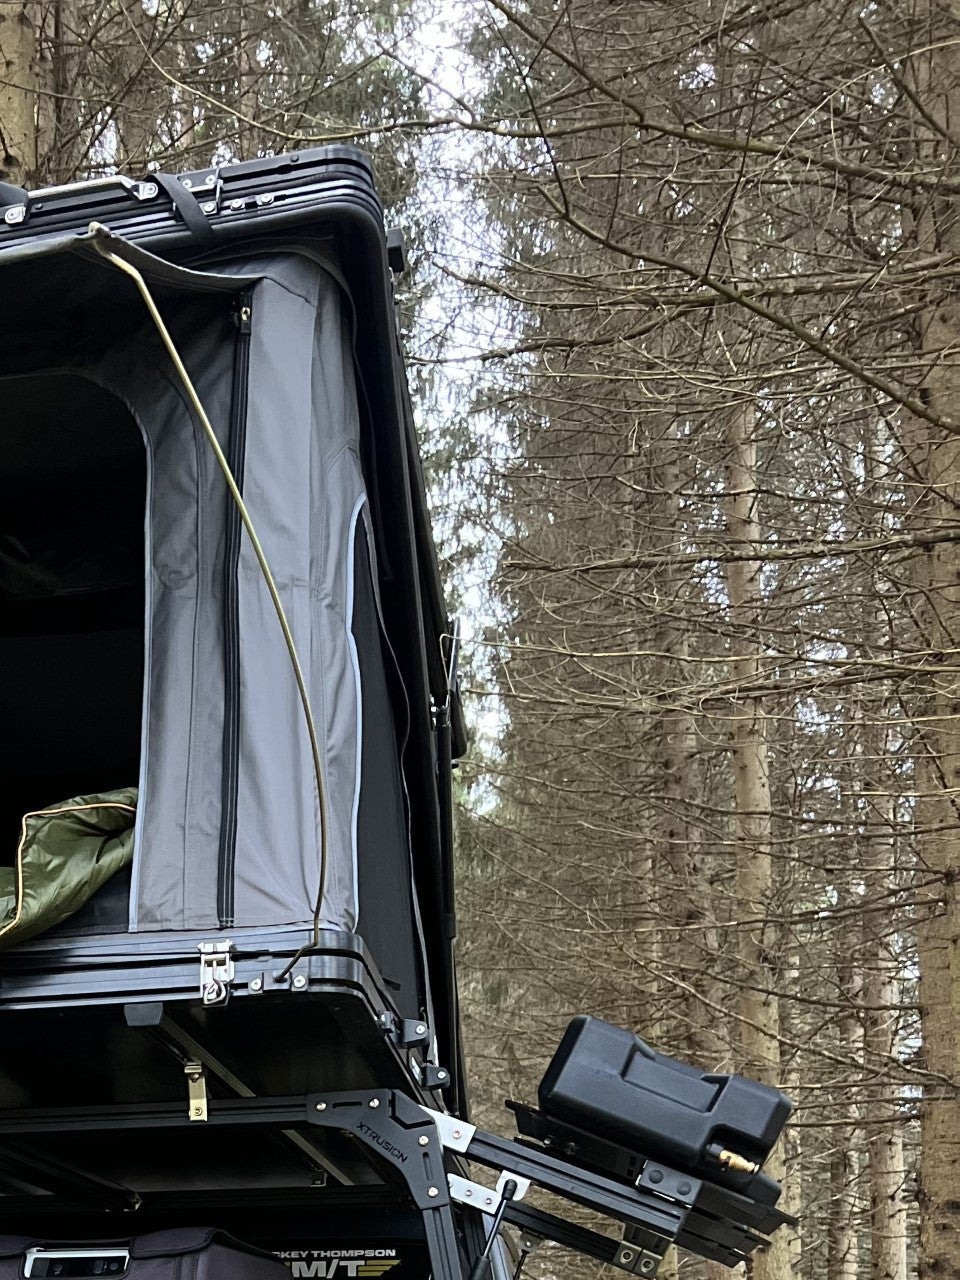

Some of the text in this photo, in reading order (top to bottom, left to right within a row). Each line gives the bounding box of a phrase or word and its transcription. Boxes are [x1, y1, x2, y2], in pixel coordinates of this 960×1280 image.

[356, 1121, 408, 1163] XTRUSION
[311, 1249, 396, 1258] THOMPSON
[291, 1258, 366, 1279] M/T
